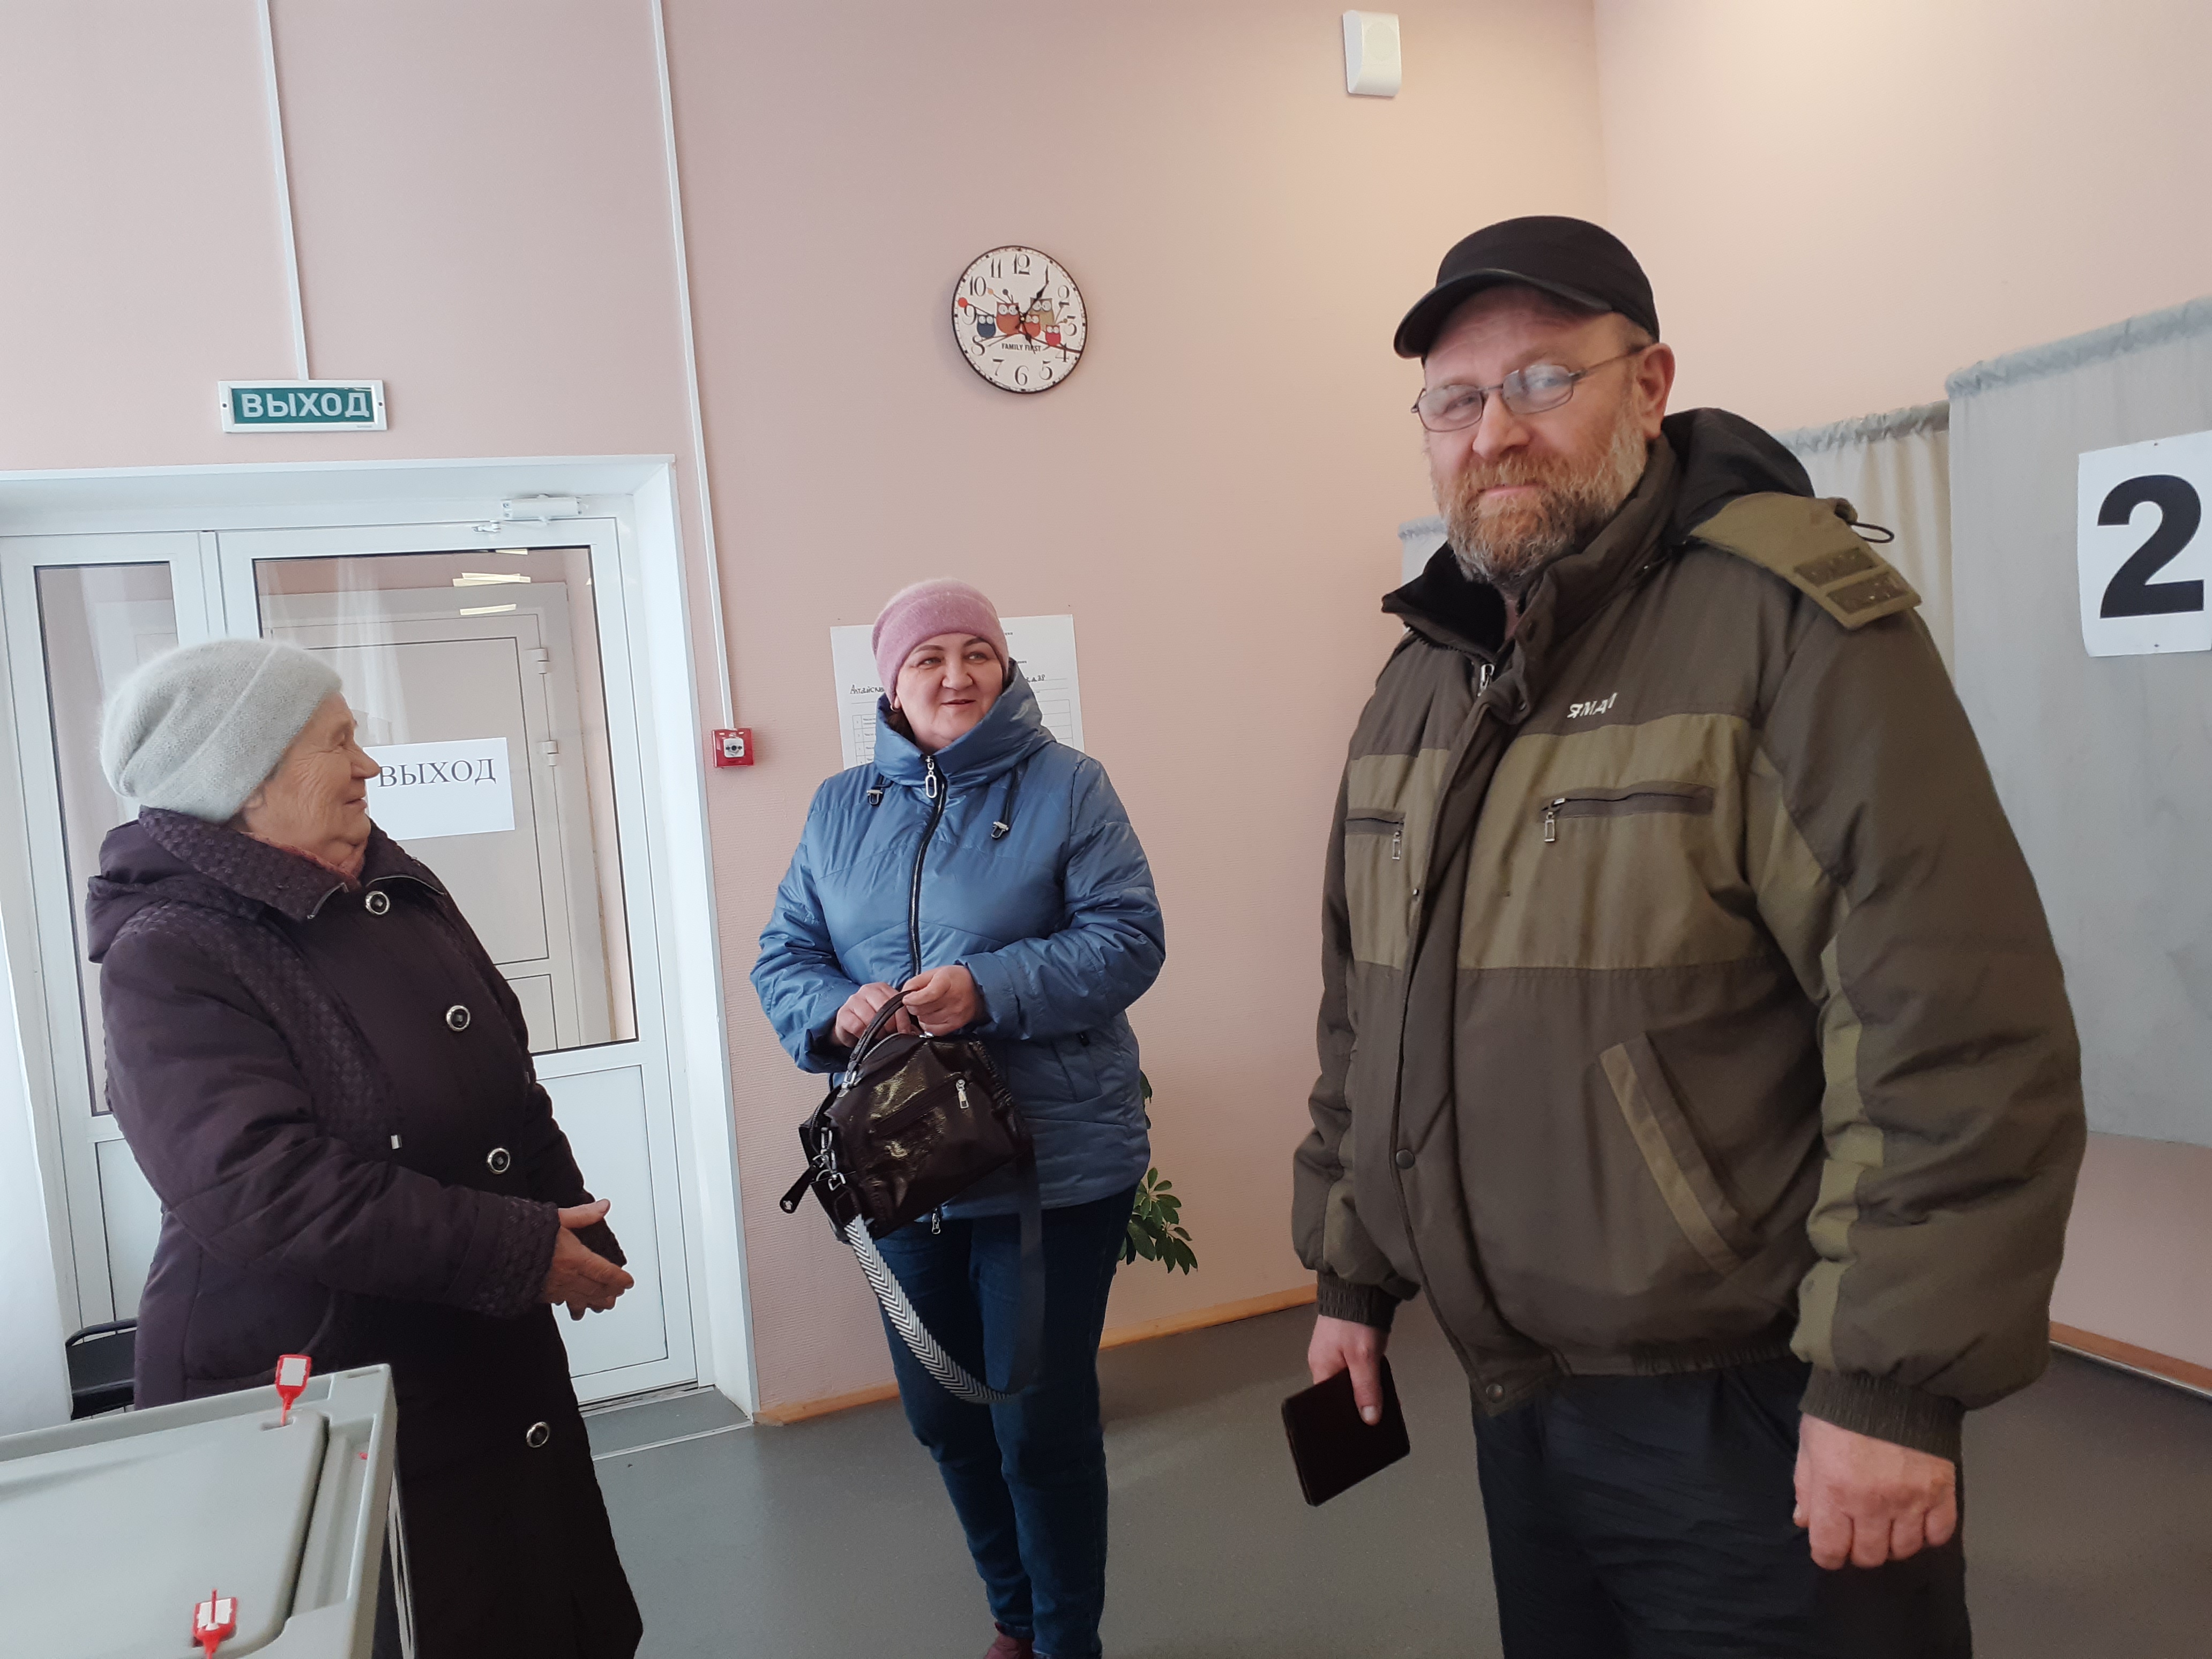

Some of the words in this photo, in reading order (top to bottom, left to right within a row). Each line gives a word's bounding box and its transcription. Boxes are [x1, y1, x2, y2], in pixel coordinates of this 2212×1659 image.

[990, 258, 1002, 279] 11
[1012, 253, 1031, 275] 12
[969, 276, 987, 296] 10
[1057, 285, 1070, 306] 2
[962, 304, 977, 325] 9
[971, 334, 985, 356] 8
[1055, 343, 1070, 362] 4
[992, 358, 1005, 376] 7
[1014, 365, 1029, 385] 6
[1040, 361, 1053, 380] 5
[241, 392, 370, 417] ВЫХОД
[2097, 474, 2204, 618] 2
[377, 758, 496, 788] ВЫХОД
